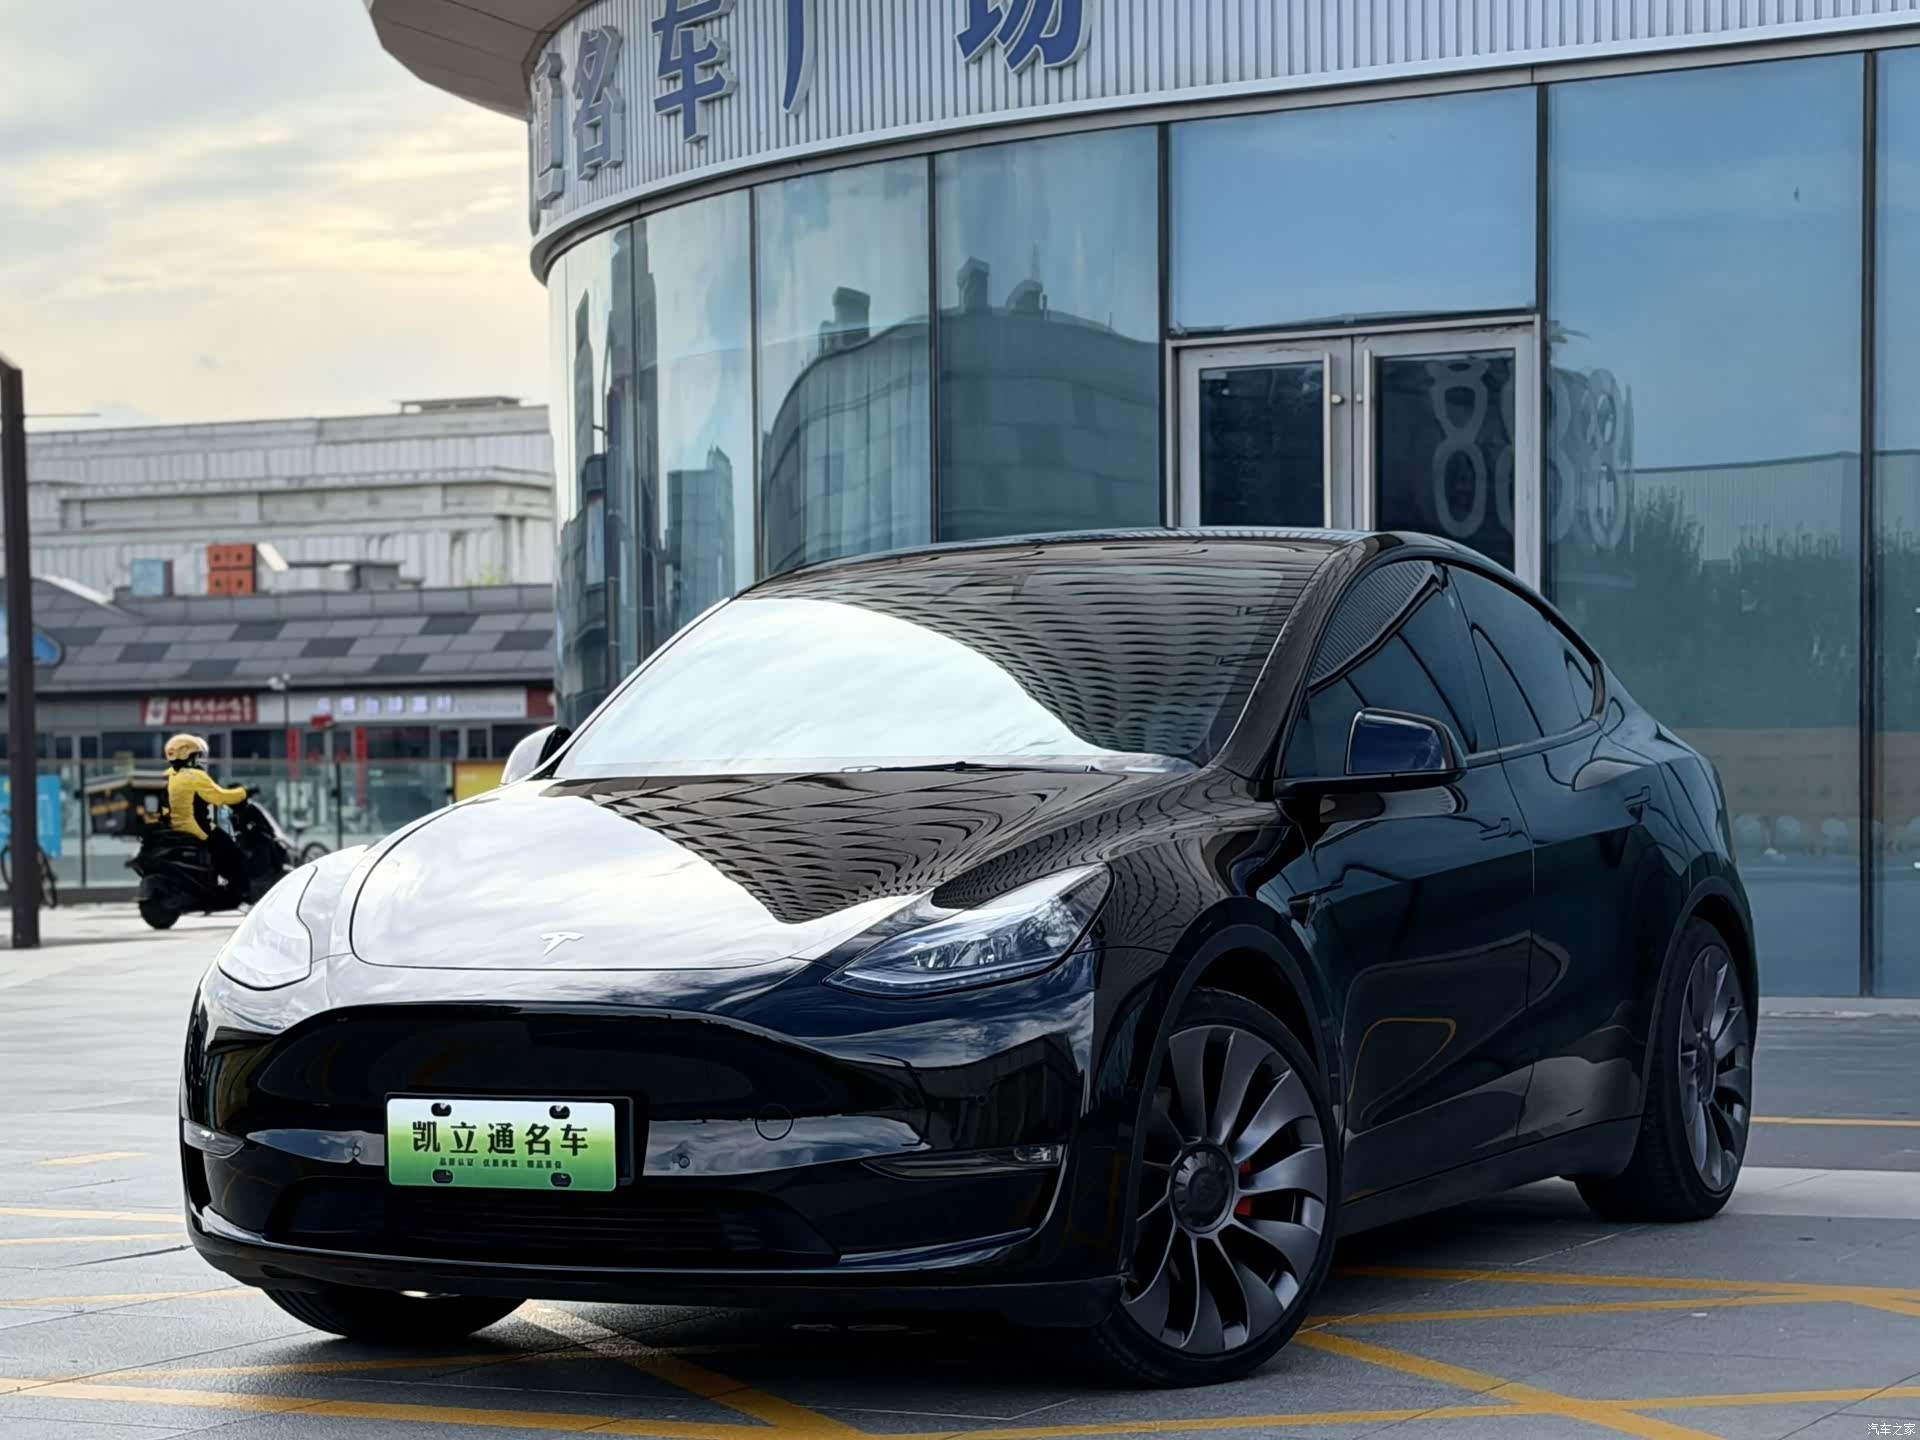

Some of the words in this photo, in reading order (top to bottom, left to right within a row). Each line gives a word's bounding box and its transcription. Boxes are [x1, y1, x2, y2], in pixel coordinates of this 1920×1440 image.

[412, 1120, 589, 1157] 凯立通名车
